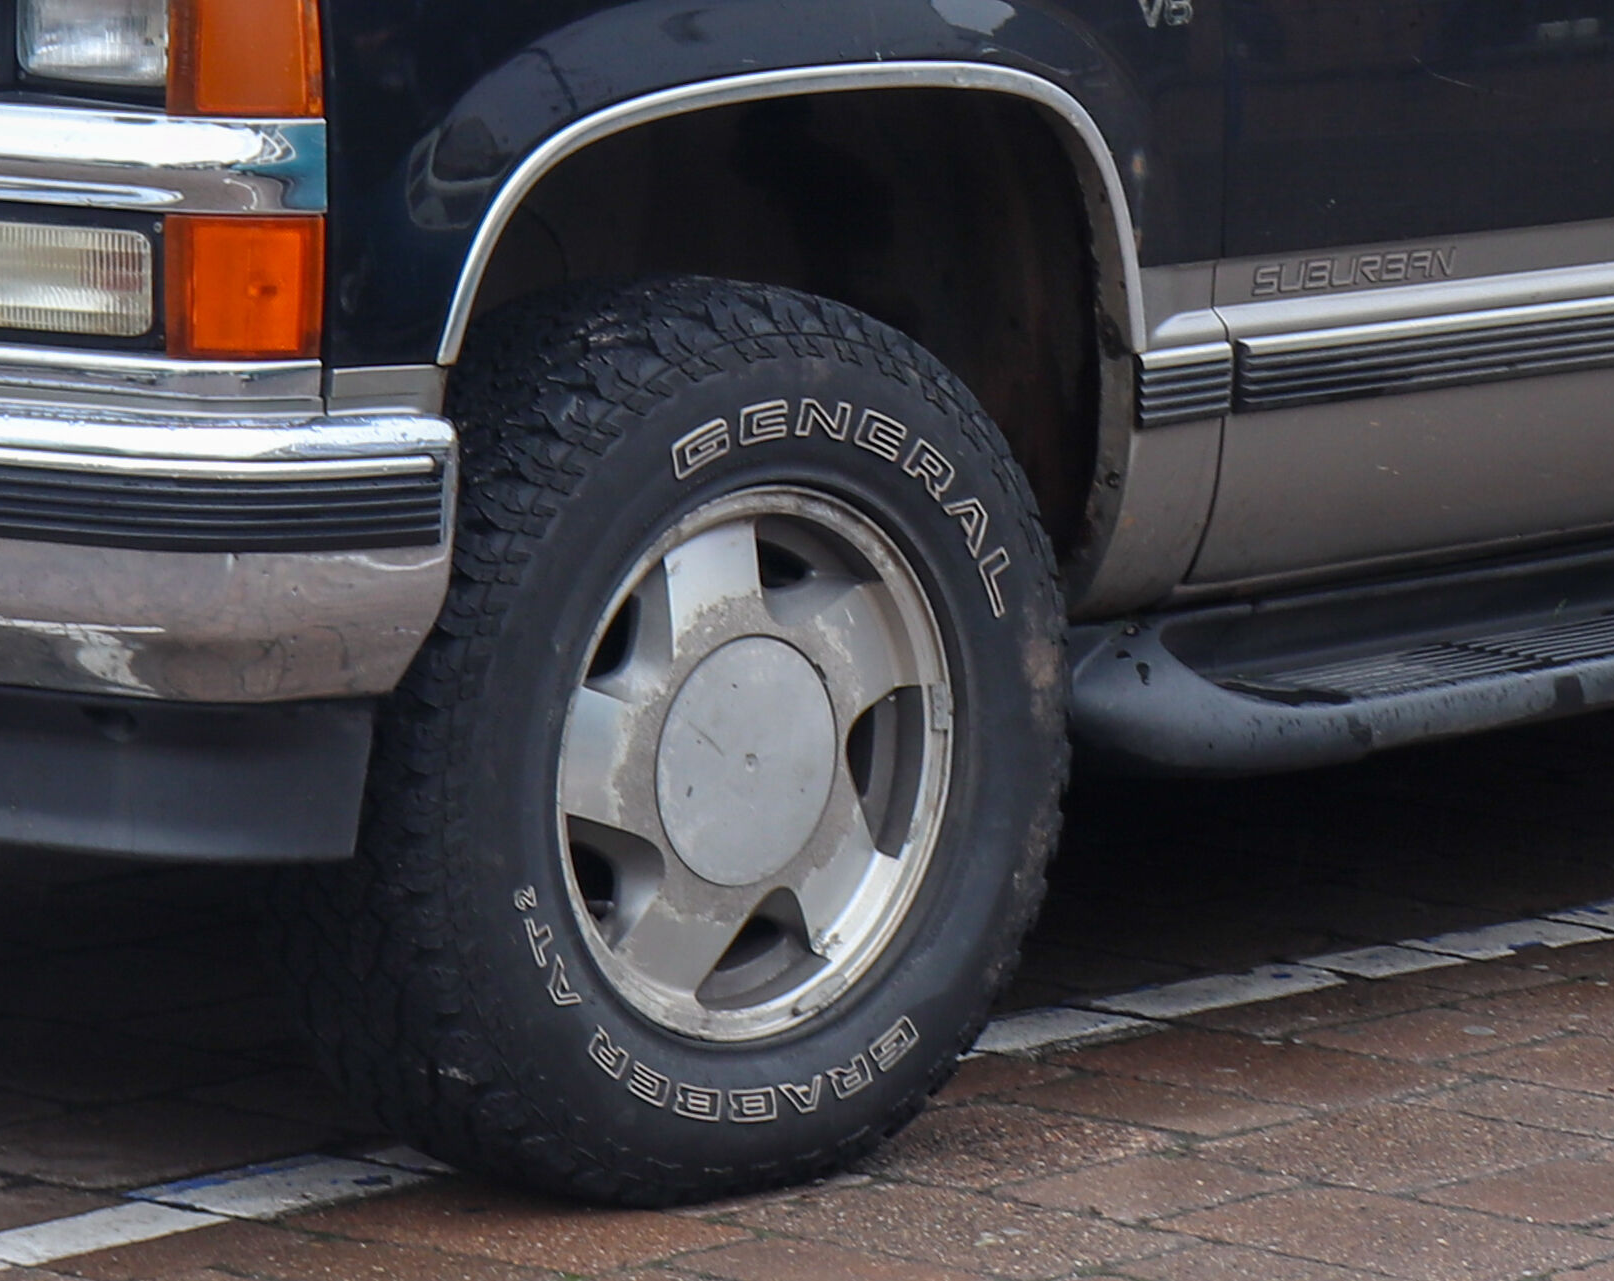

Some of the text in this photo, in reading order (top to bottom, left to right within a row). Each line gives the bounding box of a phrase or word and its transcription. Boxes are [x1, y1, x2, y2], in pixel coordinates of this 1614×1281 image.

[1251, 246, 1457, 297] SUBURBAN
[671, 398, 1011, 618] GENERAL
[587, 1015, 920, 1123] GRABBER
